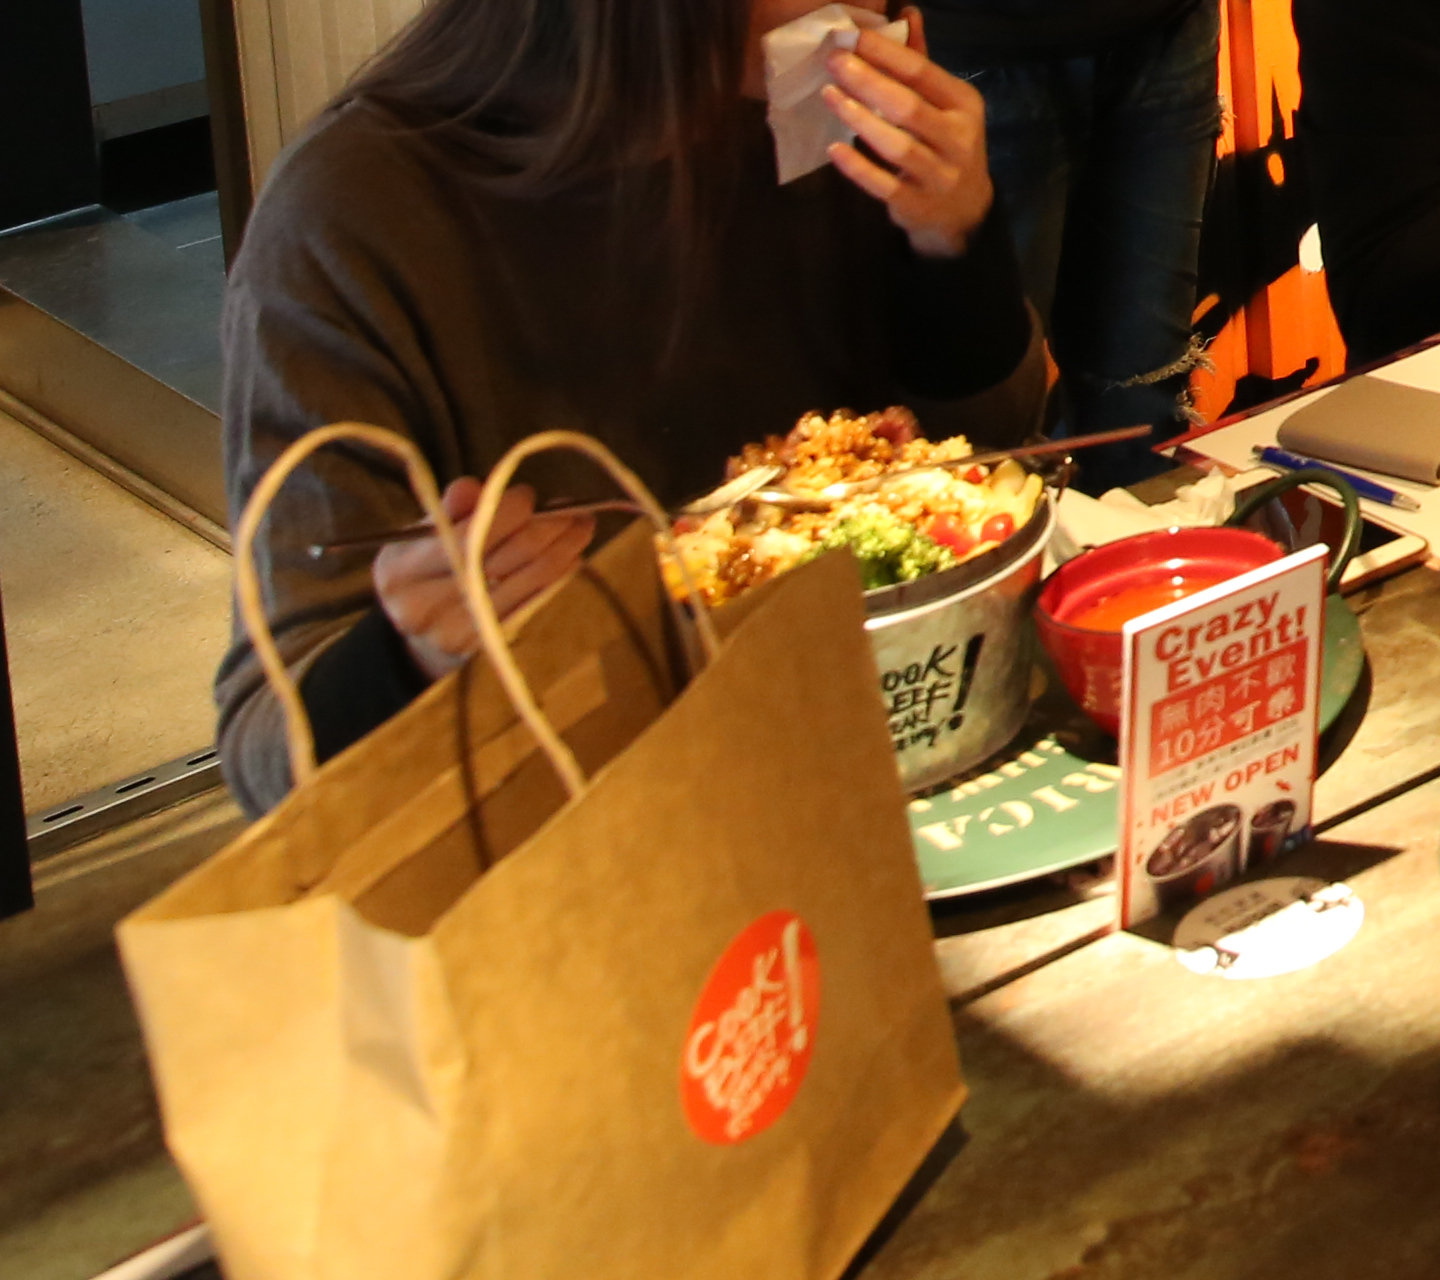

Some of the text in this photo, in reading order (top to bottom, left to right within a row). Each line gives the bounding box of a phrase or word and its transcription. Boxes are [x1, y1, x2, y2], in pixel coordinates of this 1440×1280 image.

[1155, 590, 1281, 662] Crazy
[1167, 605, 1307, 694] Event!
[882, 643, 957, 692] OOK
[1150, 782, 1215, 828] NEW
[1224, 743, 1300, 792] OPEN
